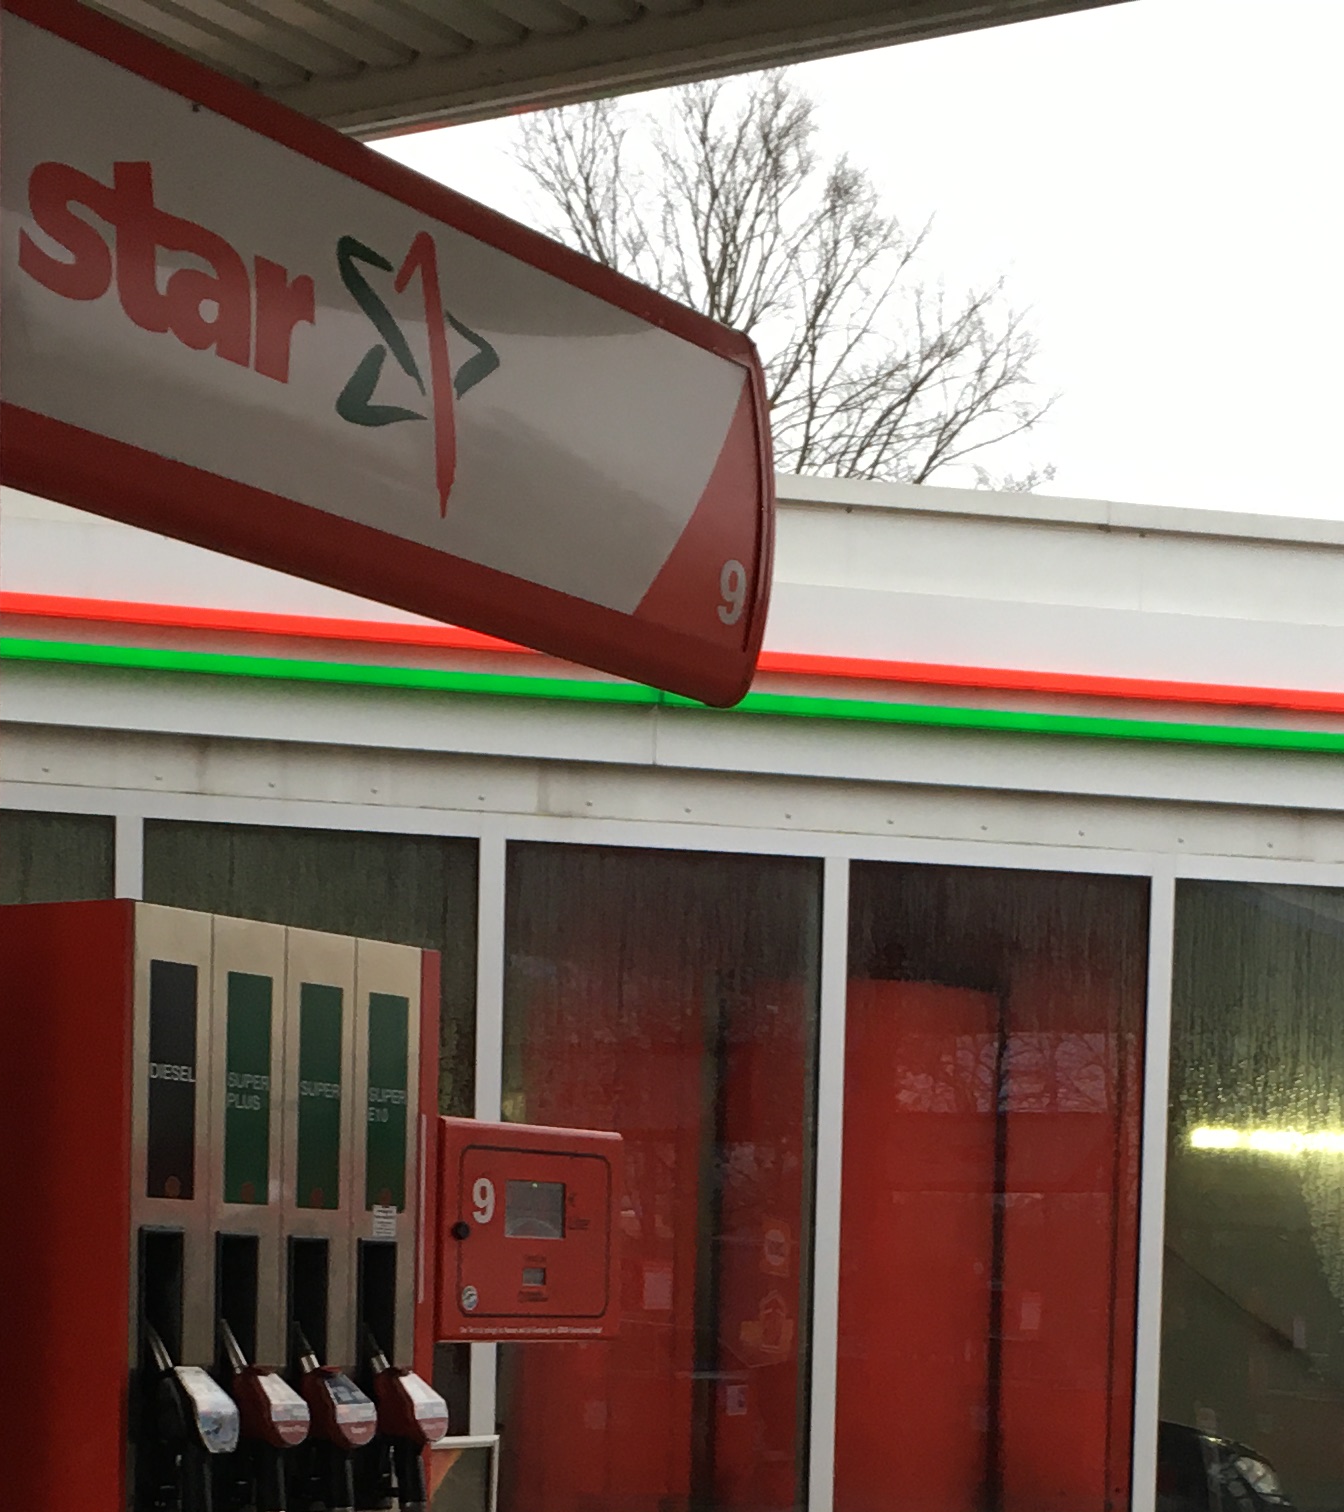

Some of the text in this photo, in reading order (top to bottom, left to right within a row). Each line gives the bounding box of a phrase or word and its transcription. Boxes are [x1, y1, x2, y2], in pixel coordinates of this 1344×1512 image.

[18, 161, 316, 384] star
[717, 559, 748, 625] 9
[149, 1062, 196, 1083] DIESEL
[227, 1071, 269, 1091] SUPER
[299, 1080, 340, 1099] SUPER
[368, 1086, 406, 1106] SUPER
[226, 1092, 262, 1111] PLUS
[368, 1106, 390, 1123] E10
[472, 1177, 496, 1224] 9
